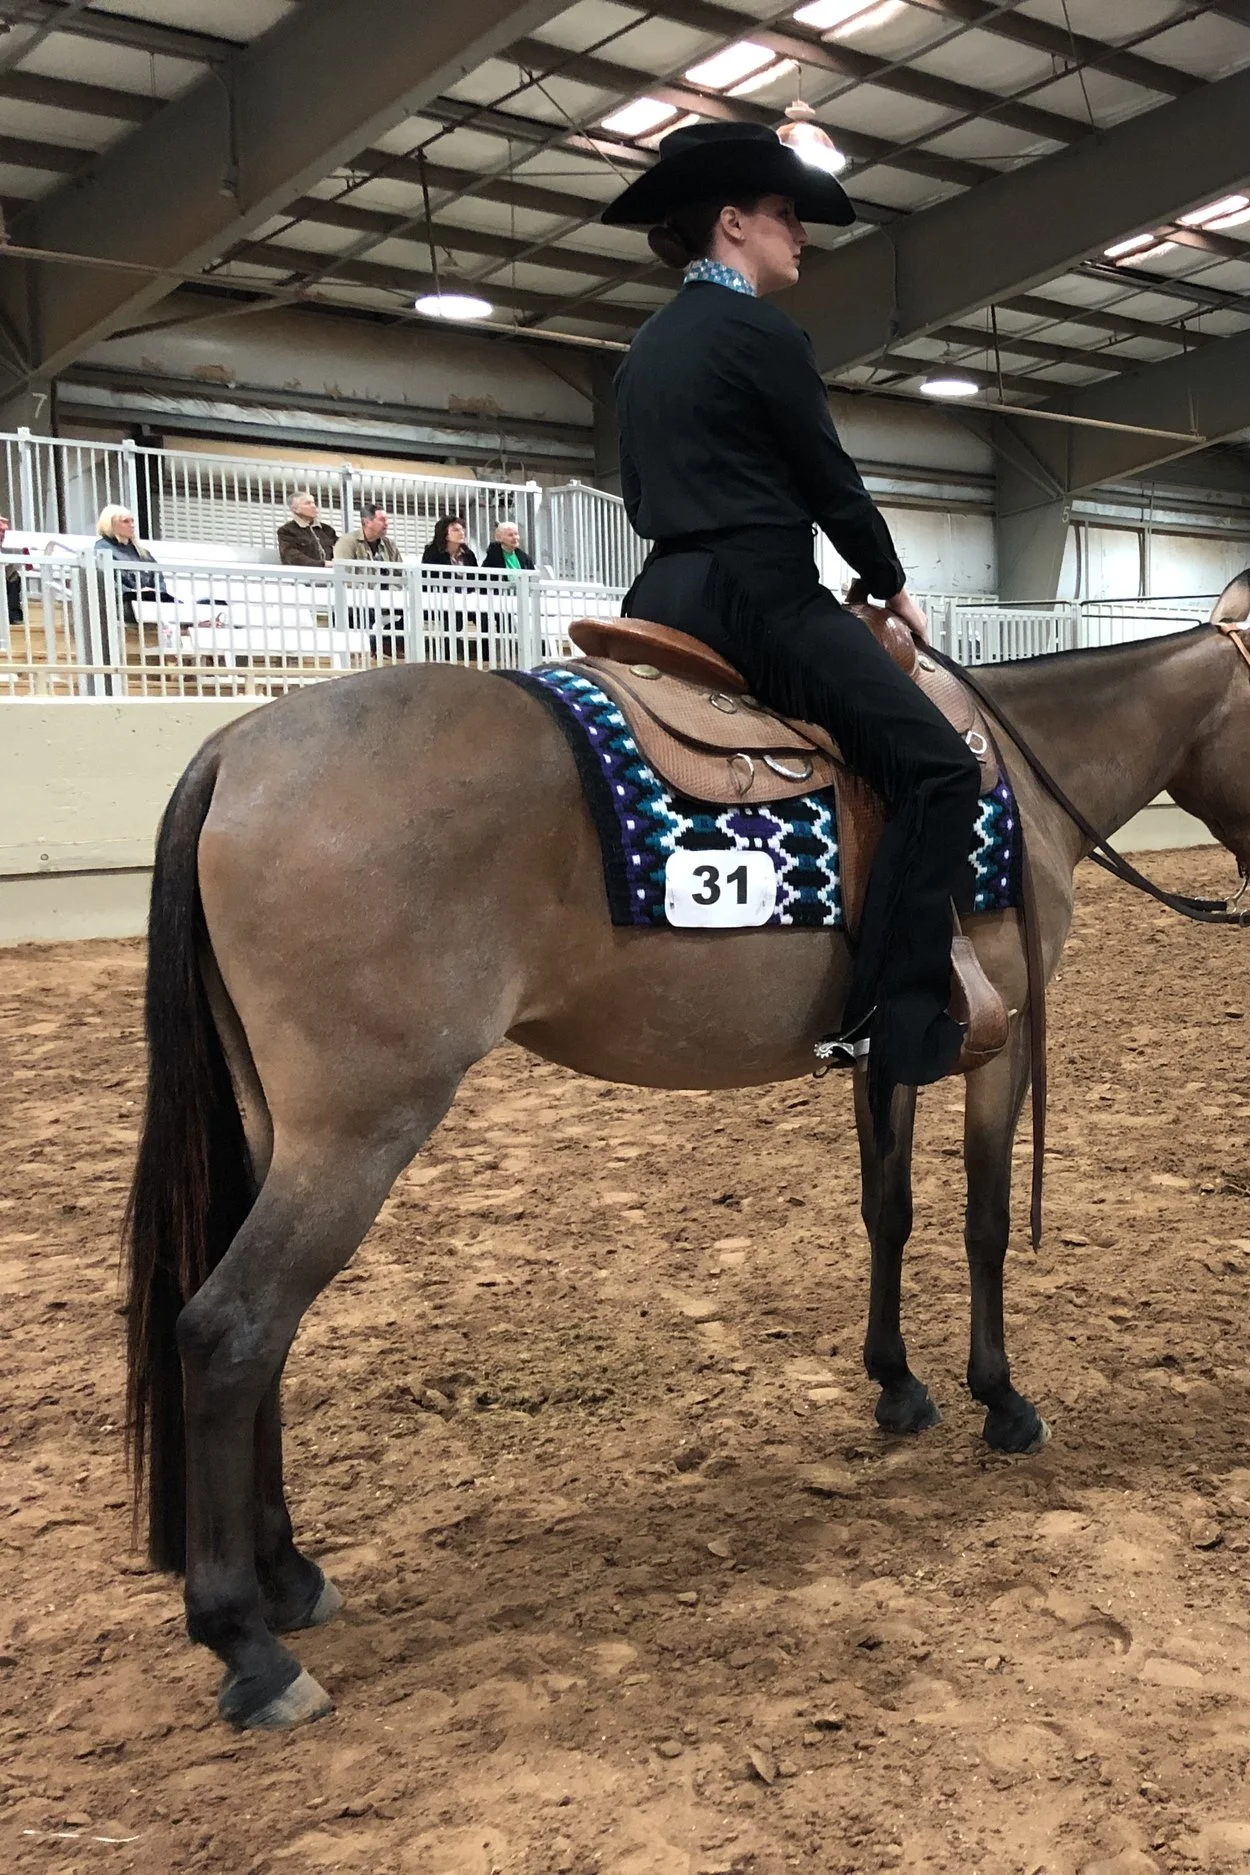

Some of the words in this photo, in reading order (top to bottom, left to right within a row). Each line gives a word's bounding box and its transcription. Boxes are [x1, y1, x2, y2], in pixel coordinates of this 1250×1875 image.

[32, 392, 48, 419] 7
[1062, 505, 1071, 523] 5
[692, 865, 747, 905] 31
